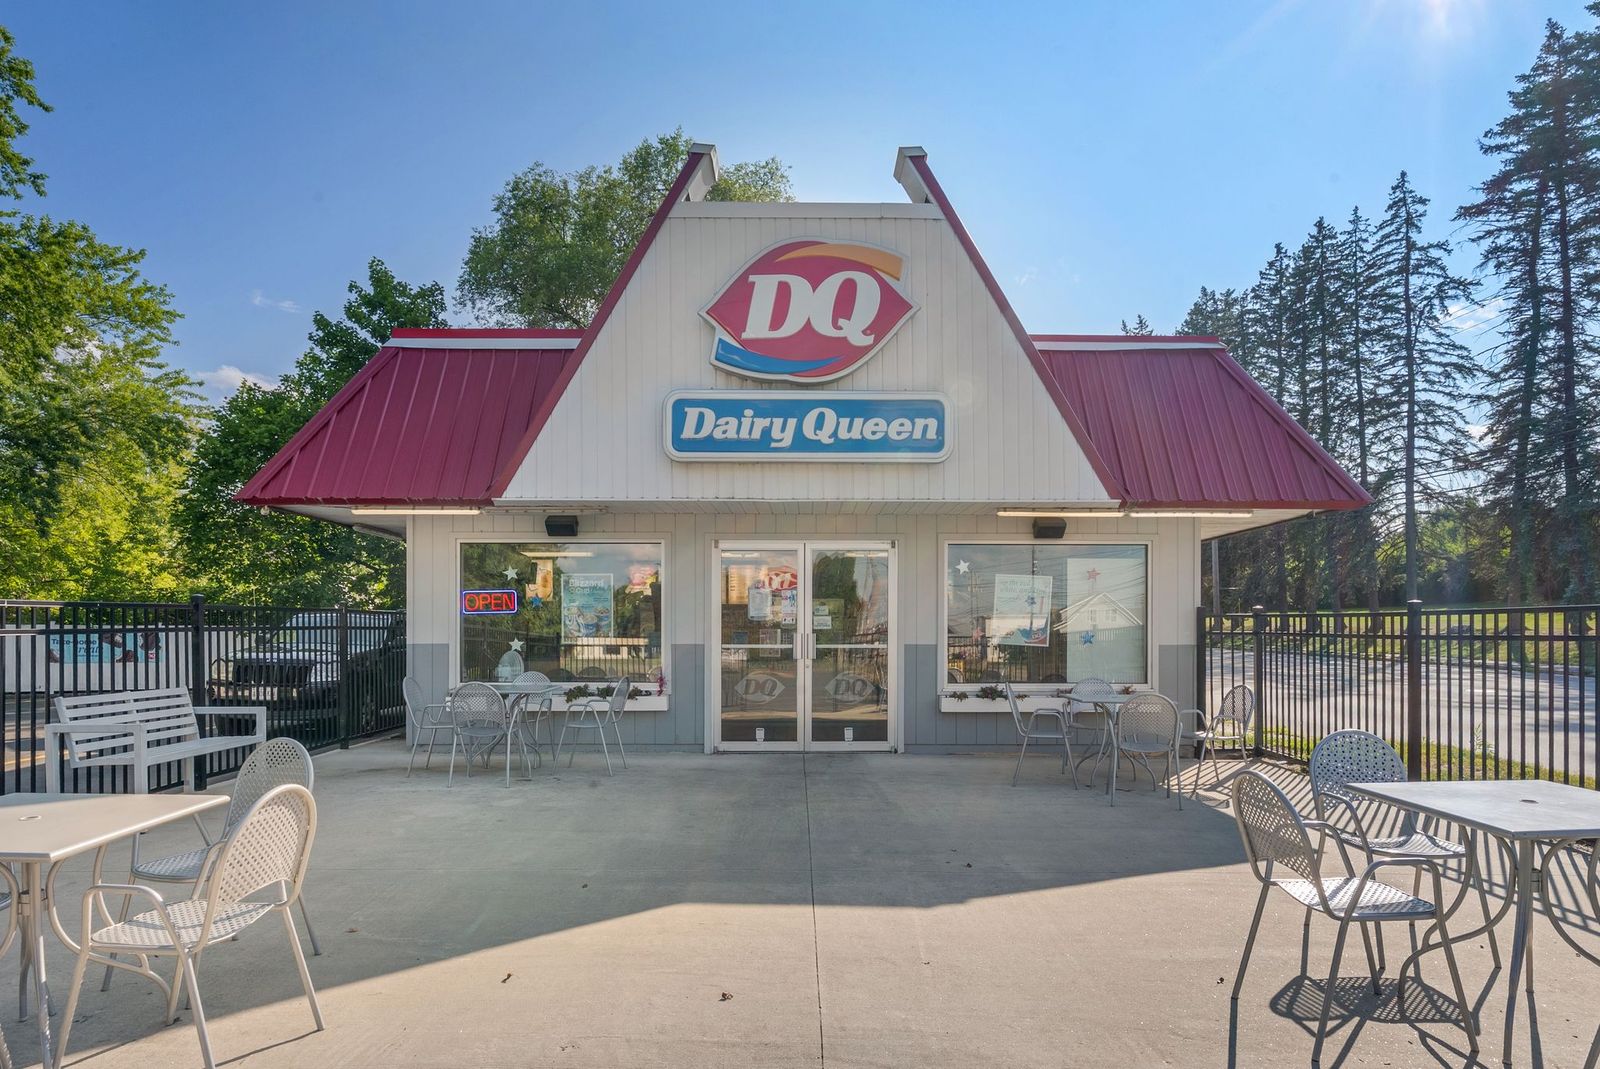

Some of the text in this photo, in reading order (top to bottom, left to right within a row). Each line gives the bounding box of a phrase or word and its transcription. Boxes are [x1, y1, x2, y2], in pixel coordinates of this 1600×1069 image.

[741, 270, 881, 346] DQ
[680, 407, 938, 448] Dairy Queen
[465, 593, 515, 611] OPEN
[743, 678, 778, 697] DQ
[833, 678, 868, 698] DQ
